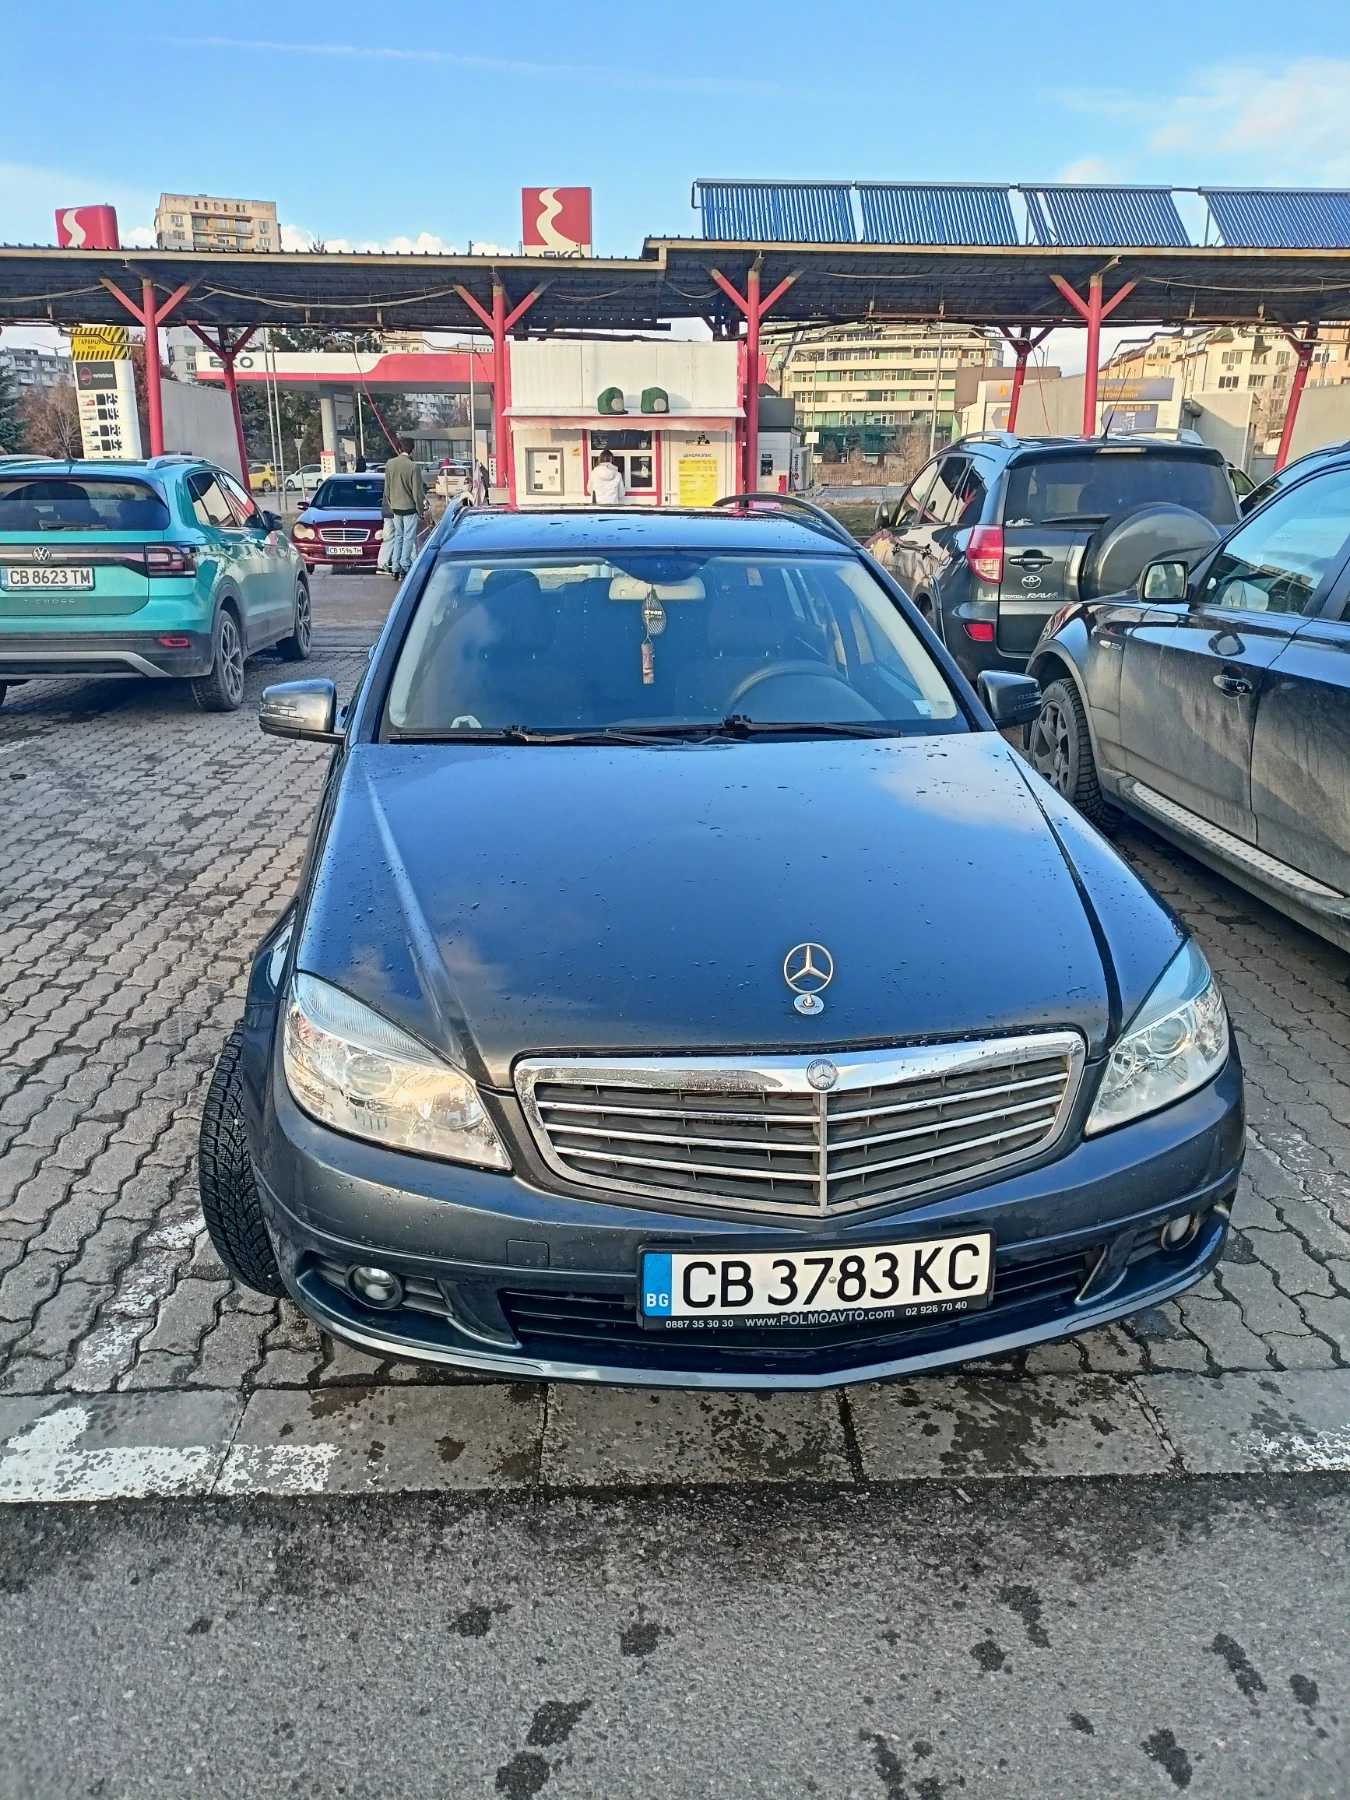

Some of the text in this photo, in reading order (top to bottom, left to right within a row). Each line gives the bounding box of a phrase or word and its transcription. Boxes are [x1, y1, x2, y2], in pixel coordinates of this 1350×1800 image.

[10, 570, 90, 585] CB 8623 TM
[683, 1243, 980, 1308] CB 3783 KC
[646, 1293, 669, 1307] BG
[905, 1300, 968, 1316] 02 926 70 40
[665, 1319, 734, 1329] 0887 35 30 30
[745, 1309, 895, 1328] www.POLMOAVTO.com
